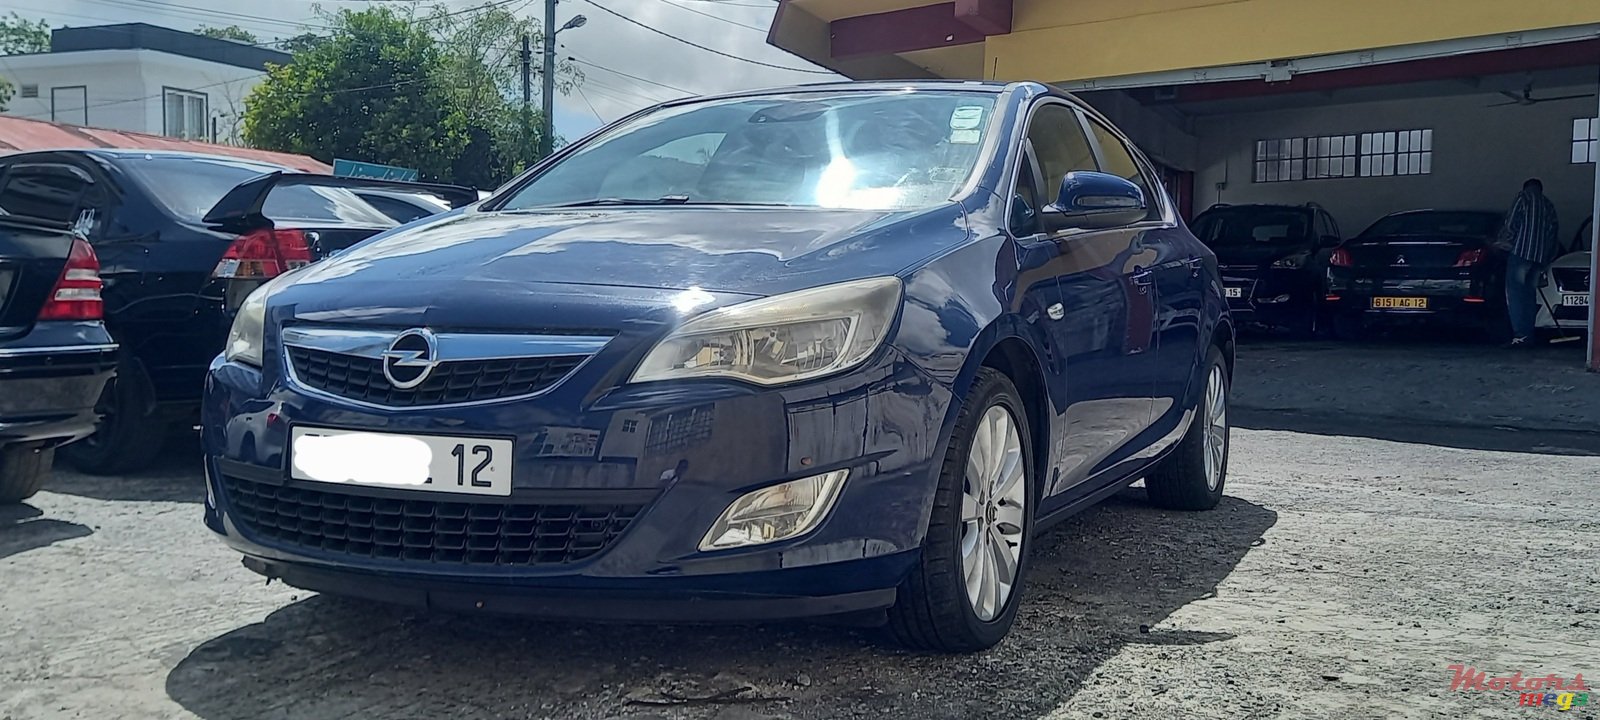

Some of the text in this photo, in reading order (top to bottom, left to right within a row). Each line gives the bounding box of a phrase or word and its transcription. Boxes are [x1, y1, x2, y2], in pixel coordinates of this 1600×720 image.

[1229, 288, 1238, 297] 15
[1375, 298, 1424, 307] 6151 AG 12
[451, 443, 493, 488] 12
